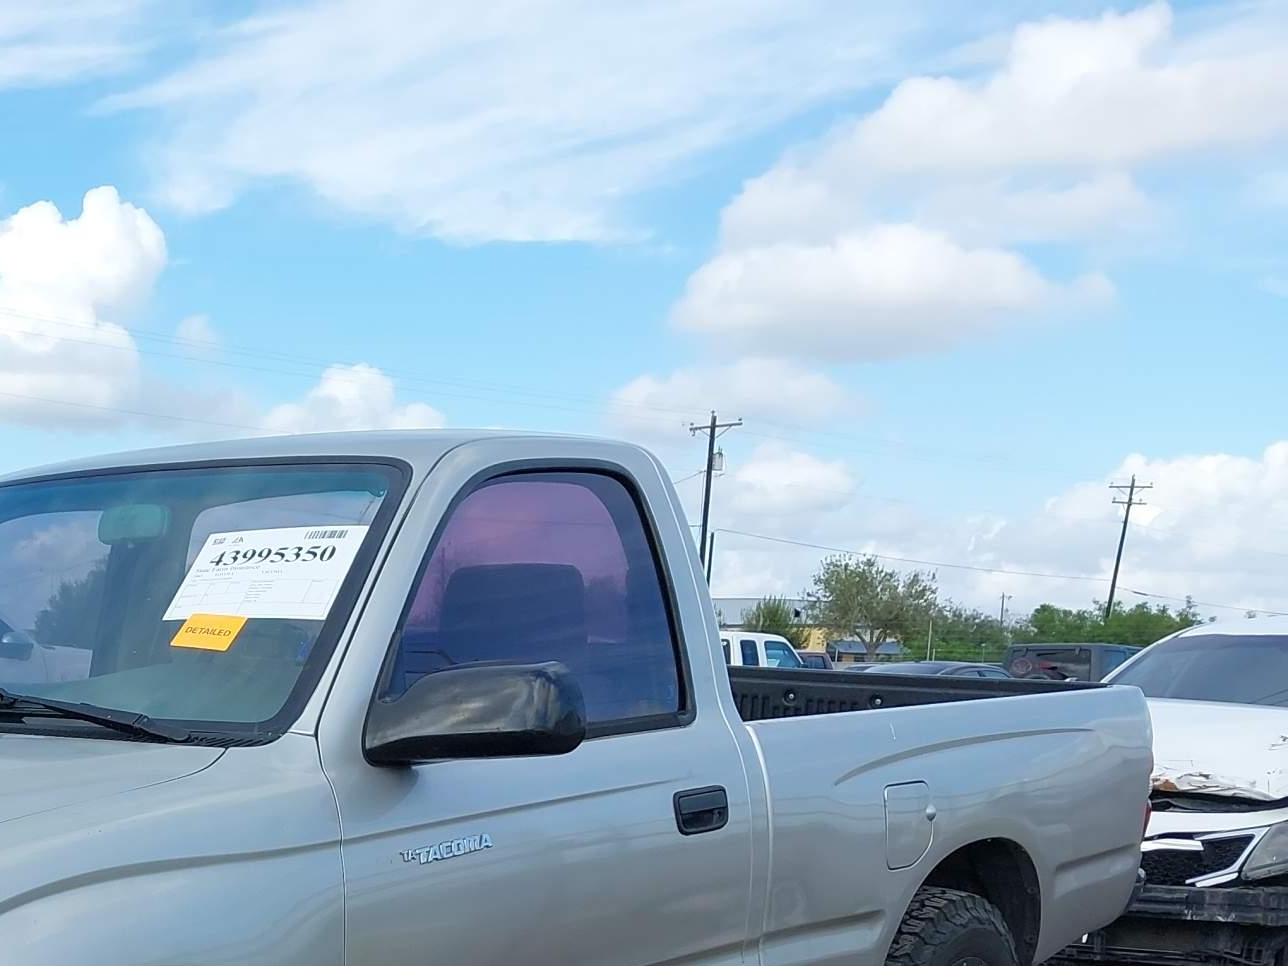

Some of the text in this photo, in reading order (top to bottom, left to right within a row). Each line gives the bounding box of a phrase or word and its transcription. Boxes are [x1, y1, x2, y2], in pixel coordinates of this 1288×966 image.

[209, 545, 337, 567] 43995350
[184, 626, 232, 637] DETAILED
[415, 833, 493, 865] TACOMA
